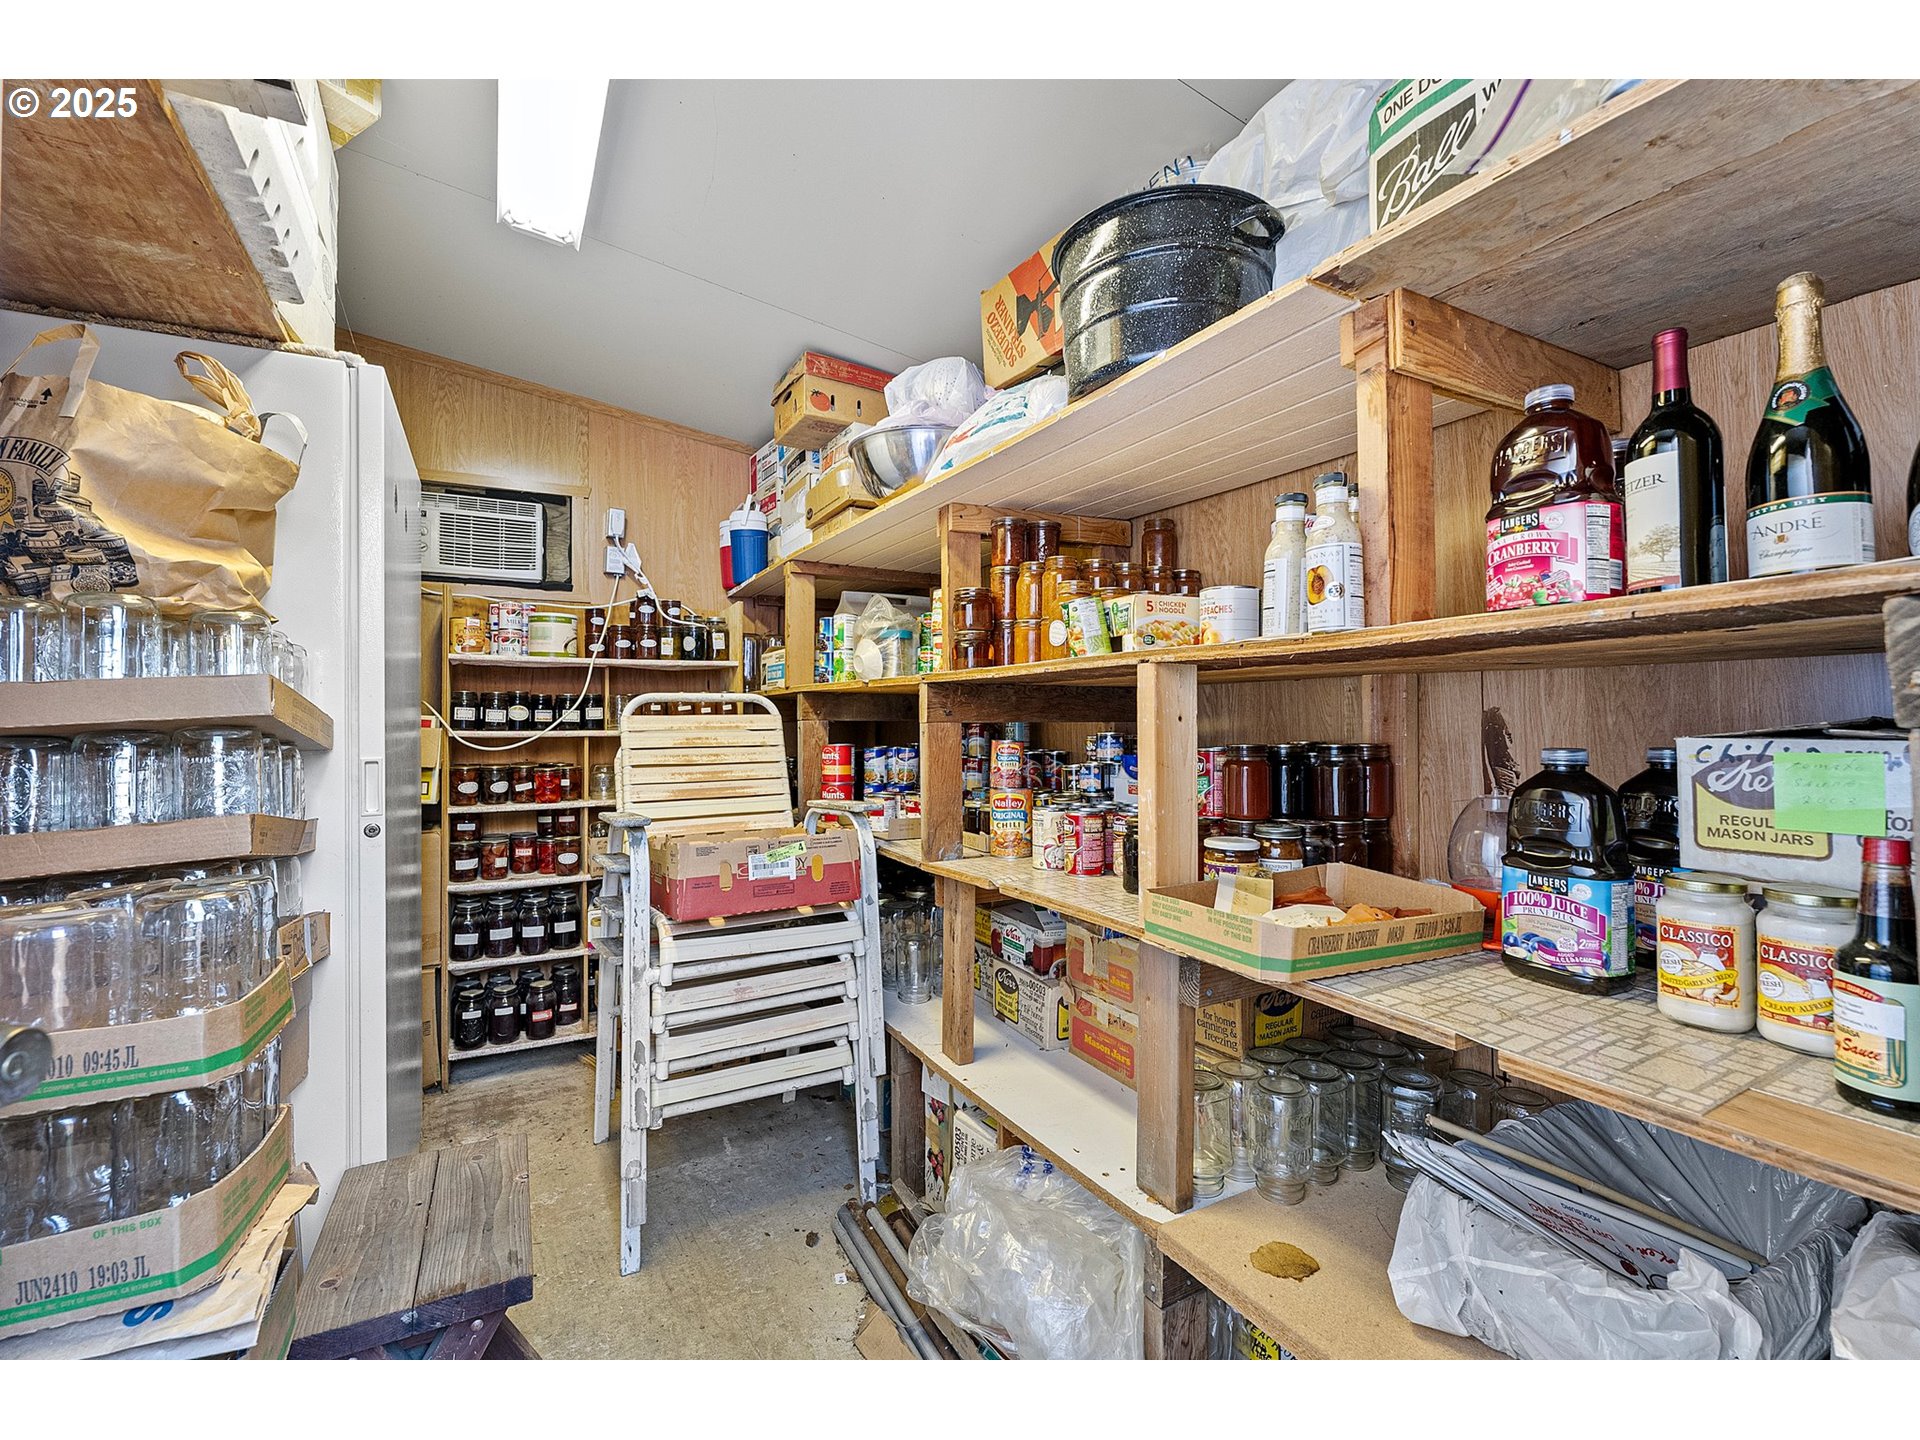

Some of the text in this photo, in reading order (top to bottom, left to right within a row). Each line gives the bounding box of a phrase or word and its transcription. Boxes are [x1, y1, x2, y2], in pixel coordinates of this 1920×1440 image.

[1383, 87, 1414, 124] ONE
[1378, 108, 1475, 229] Ball
[994, 293, 1027, 358] STRAINER
[986, 311, 1018, 368] SQUEEZO
[9, 439, 64, 472] FAMILY
[1749, 496, 1828, 517] EXTRA DRY
[1500, 512, 1539, 534] LANGERS
[1751, 510, 1824, 540] ANDRÉ
[1488, 541, 1560, 567] CRANBERRY
[1146, 600, 1187, 612] 5 CHICKEN
[1159, 607, 1185, 615] NOODLE
[1204, 604, 1234, 616] PEACHES
[1000, 747, 1019, 755] Nalley
[994, 799, 1024, 809] Nalley
[992, 811, 1026, 820] ORIGINAL
[996, 821, 1021, 829] CHILI
[1707, 827, 1814, 846] MASON JARS
[1528, 874, 1568, 893] LANGERS
[1513, 891, 1588, 919] 100% JUICE
[1522, 906, 1574, 922] PRUNE PLUS
[1225, 920, 1253, 934] PRODUCTION
[1661, 925, 1733, 948] CLASSICO
[1307, 932, 1345, 956] CRANBERRY
[1346, 927, 1380, 951] RASPBERRY
[1579, 939, 1586, 949] 2
[997, 968, 1018, 990] Kerr
[1110, 975, 1131, 991] Jars
[1684, 978, 1706, 988] GARLIC
[1706, 973, 1735, 985] ALFREDO
[1764, 999, 1797, 1013] CREAMY
[1196, 1018, 1238, 1038] canning &
[1202, 1009, 1237, 1029] for home
[1265, 1017, 1294, 1031] REGULAR
[1204, 1031, 1239, 1052] freezing
[1259, 1025, 1298, 1041] MASON JARS
[1083, 1033, 1132, 1067] Mason Jars
[1842, 1037, 1882, 1060] Sauce
[83, 1048, 121, 1074] 09:45
[123, 1044, 140, 1069] JL
[92, 1216, 163, 1240] OF THIS BOX
[14, 1254, 151, 1306] JUN2410 19:03 JL
